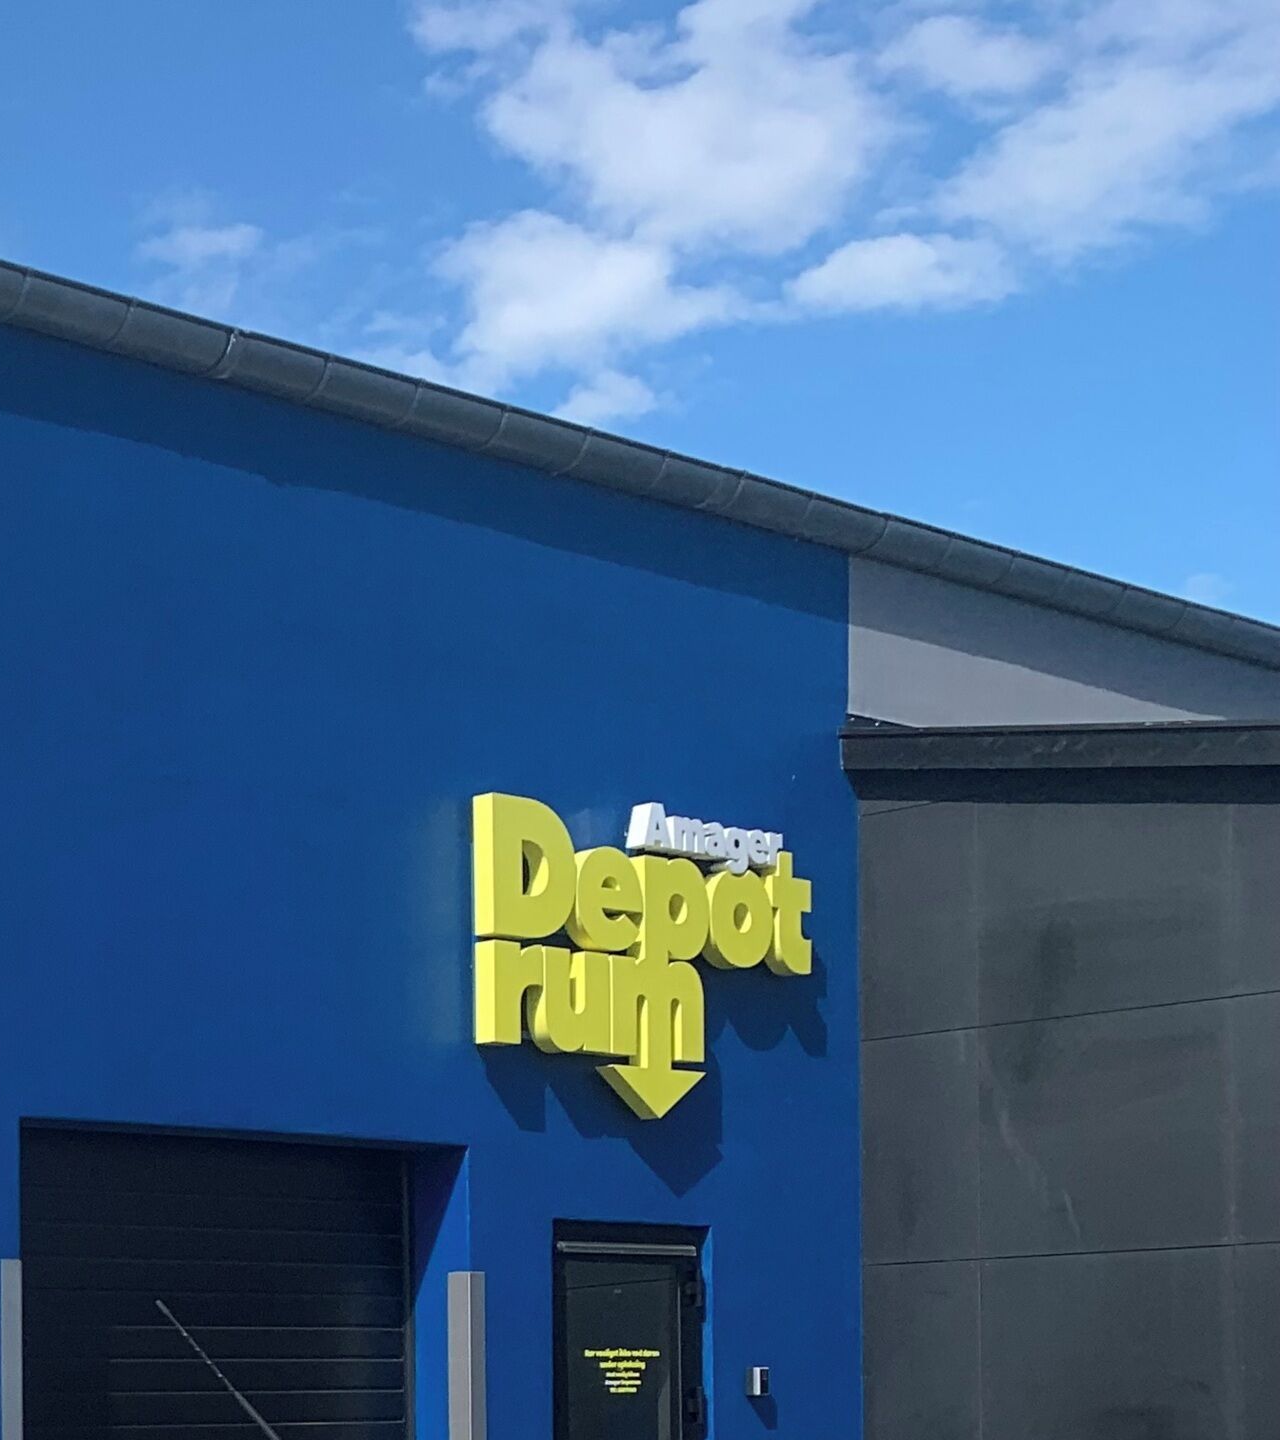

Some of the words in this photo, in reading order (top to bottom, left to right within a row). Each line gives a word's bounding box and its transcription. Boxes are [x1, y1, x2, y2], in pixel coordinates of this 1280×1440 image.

[473, 791, 812, 975] Depot
[626, 802, 783, 875] Amager
[474, 939, 705, 1070] rum
